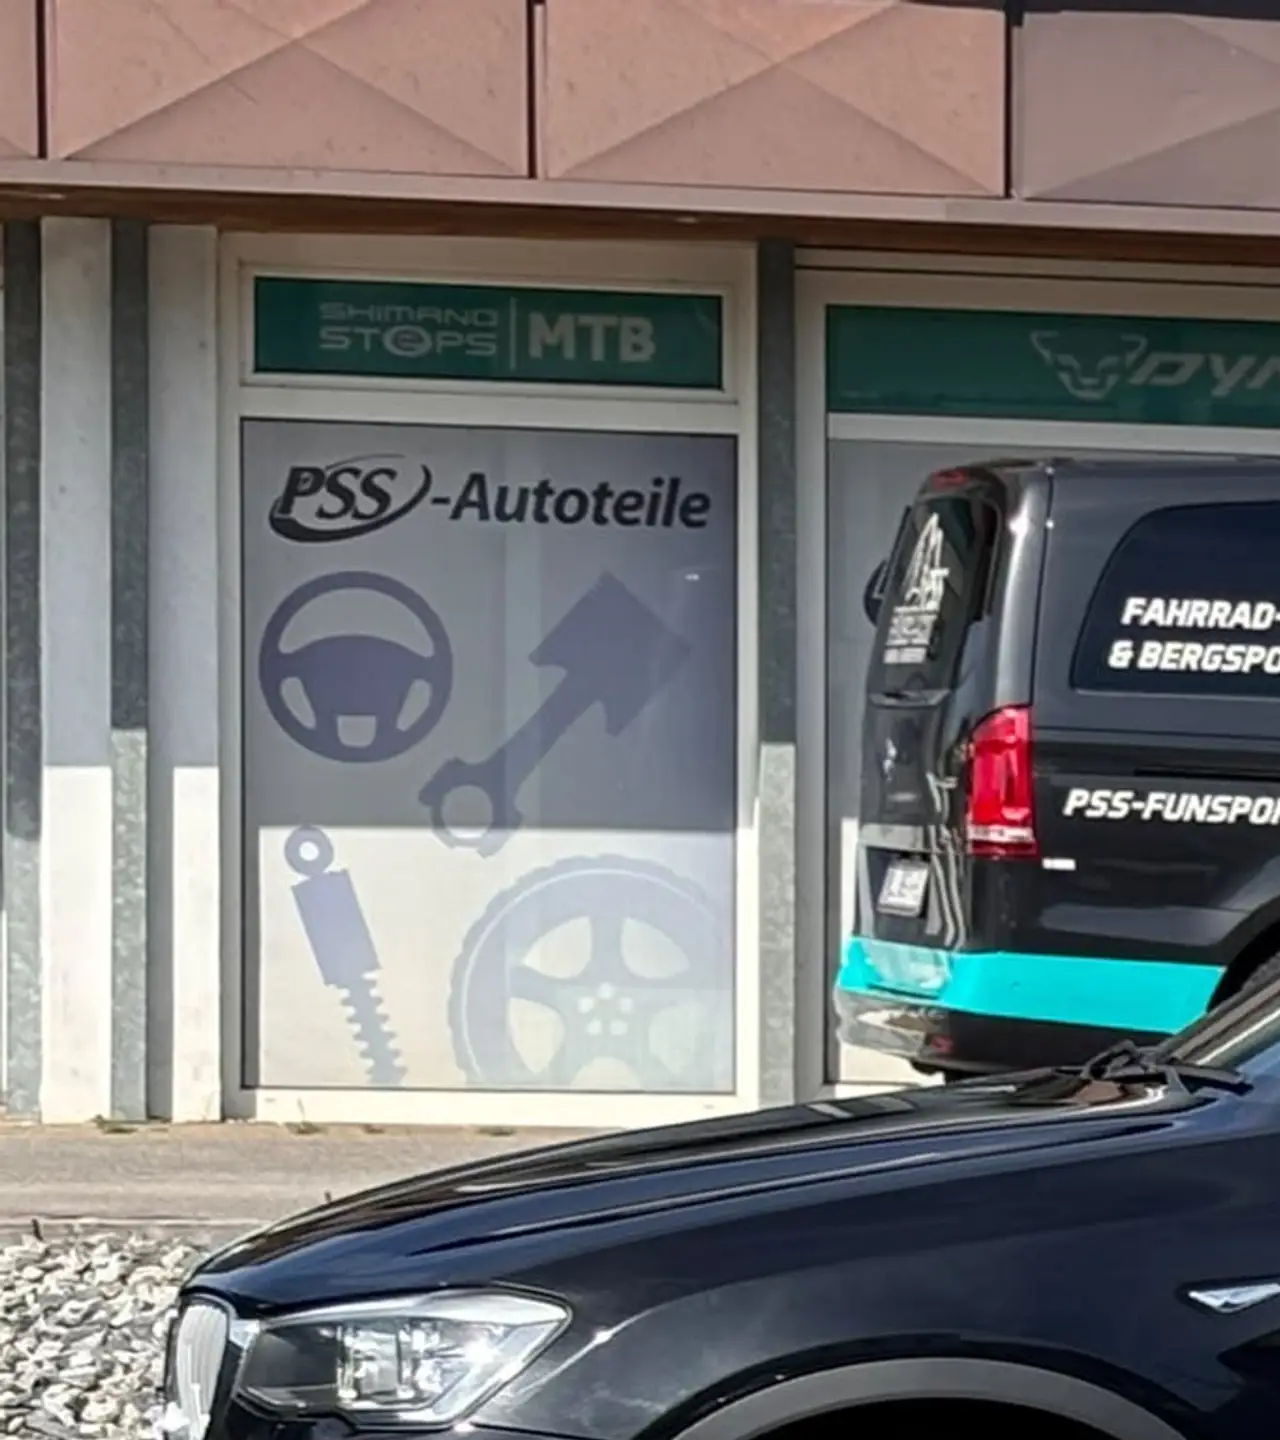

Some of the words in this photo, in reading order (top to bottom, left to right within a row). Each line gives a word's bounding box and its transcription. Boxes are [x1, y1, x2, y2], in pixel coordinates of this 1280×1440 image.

[318, 301, 499, 327] SHIMANO
[527, 310, 656, 364] MTB
[1107, 639, 1134, 669] &
